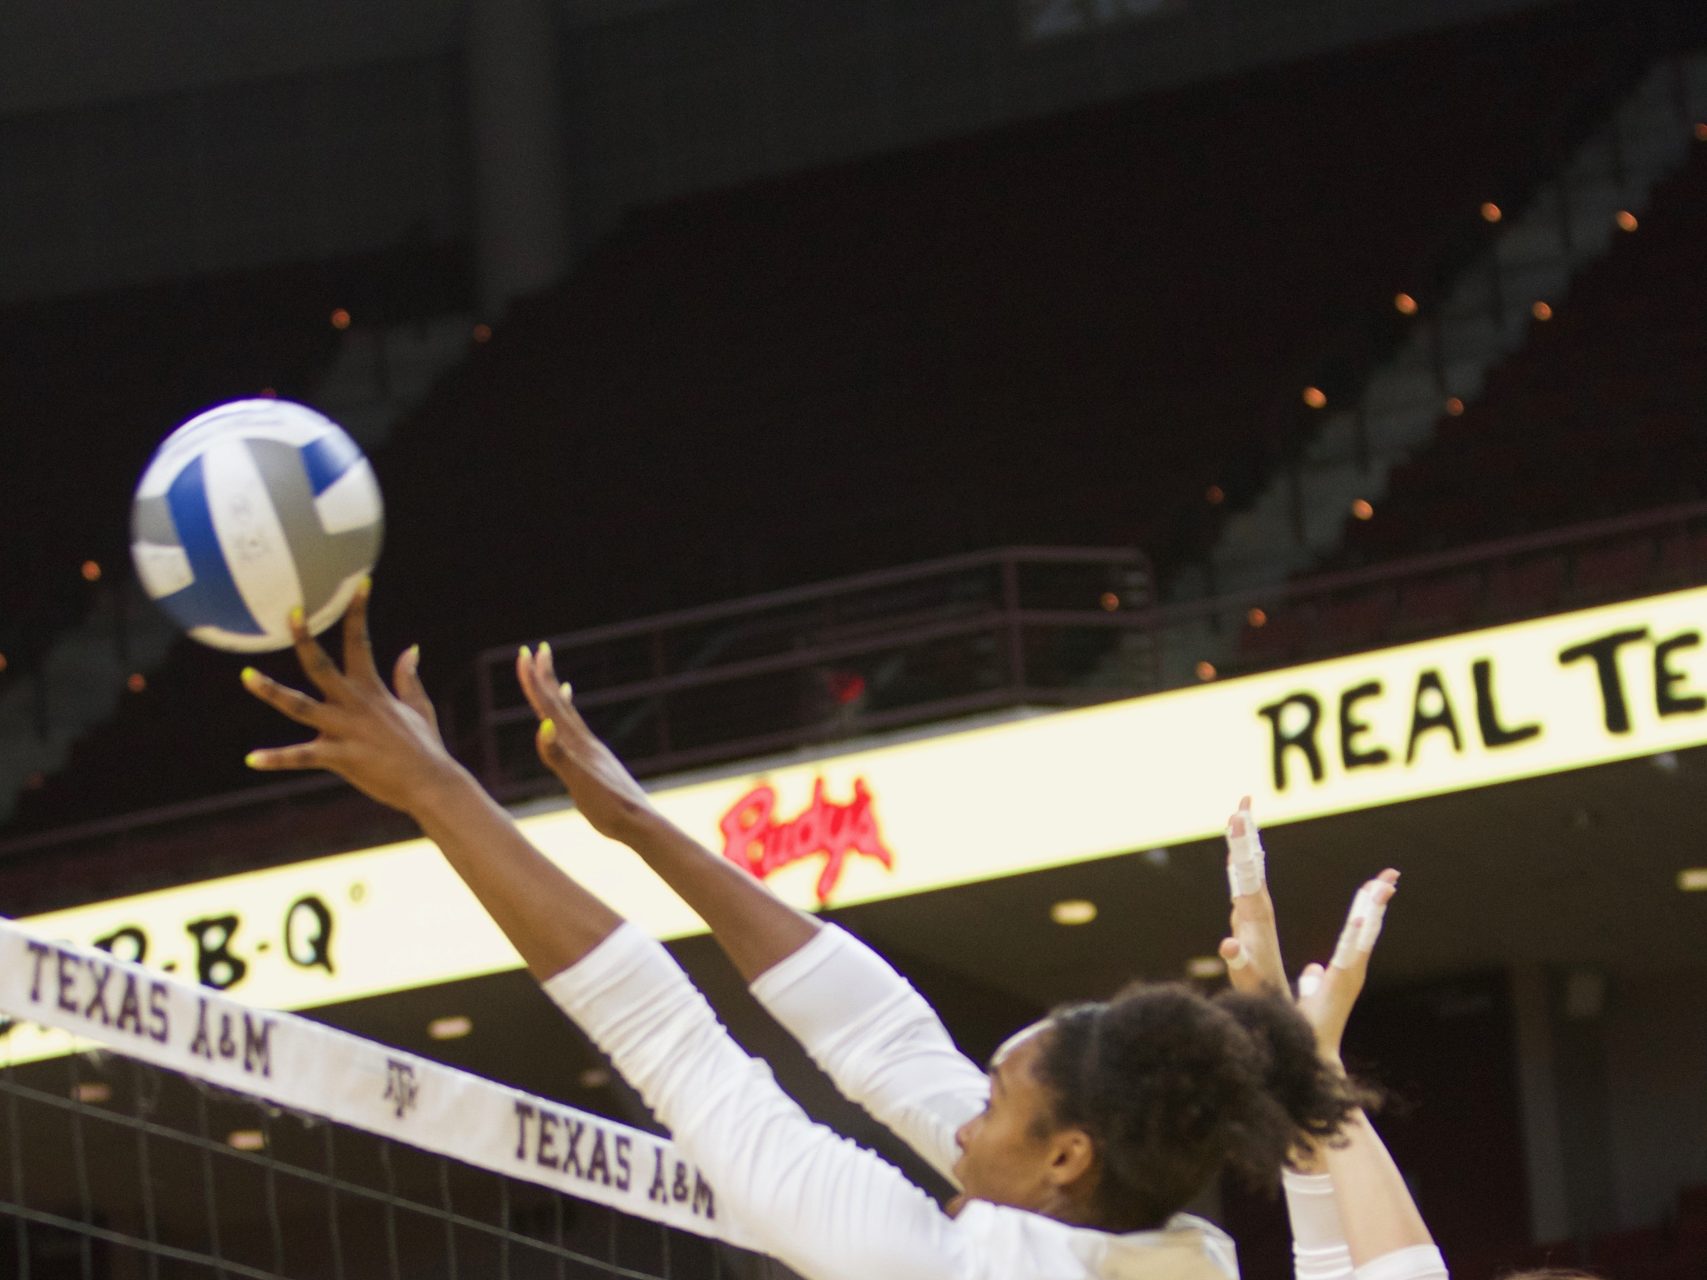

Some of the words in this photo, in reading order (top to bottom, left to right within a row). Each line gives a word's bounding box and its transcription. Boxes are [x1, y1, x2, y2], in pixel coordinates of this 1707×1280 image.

[1257, 657, 1542, 792] REAL
[1558, 624, 1707, 735] TE
[27, 938, 170, 1044] TEXAS
[189, 996, 278, 1078] A&M
[513, 1099, 632, 1193] TEXAS
[648, 1146, 717, 1220] A&M
